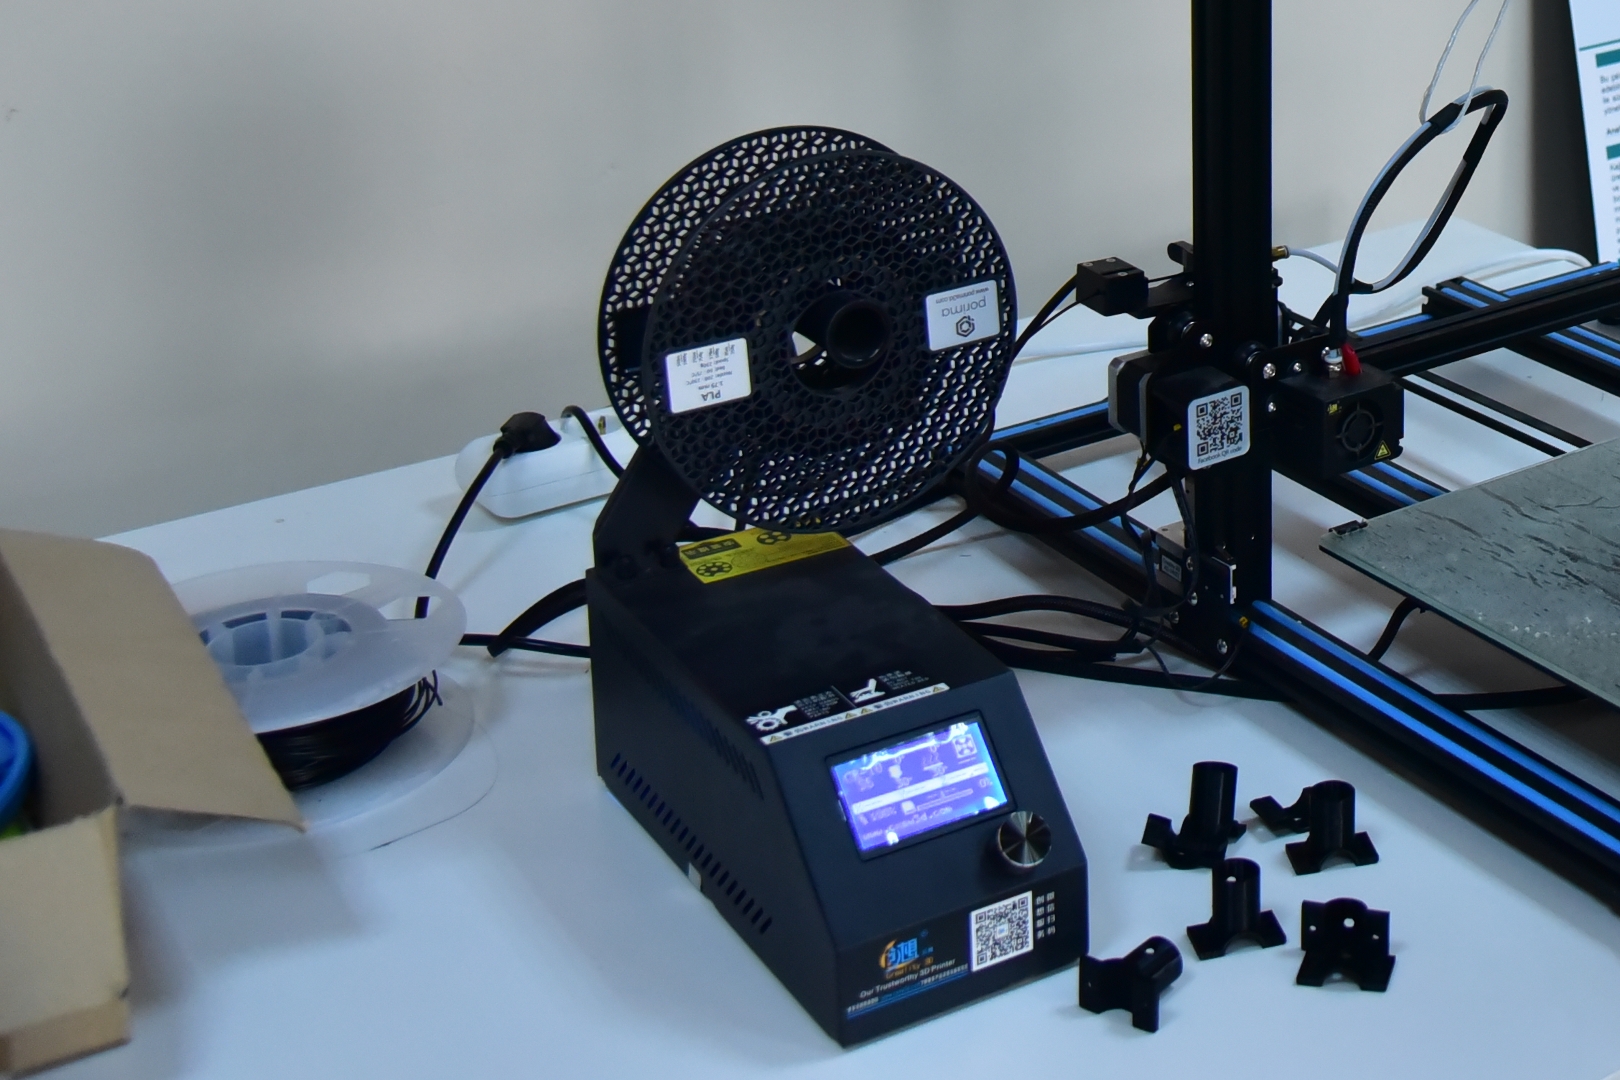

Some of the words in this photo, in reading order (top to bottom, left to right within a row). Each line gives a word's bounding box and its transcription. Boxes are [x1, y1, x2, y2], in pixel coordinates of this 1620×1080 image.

[941, 296, 986, 317] porima
[701, 390, 721, 401] PLA
[860, 988, 874, 999] Our
[876, 969, 918, 992] Trustworthy
[920, 967, 931, 977] 3D
[931, 959, 956, 973] Printer
